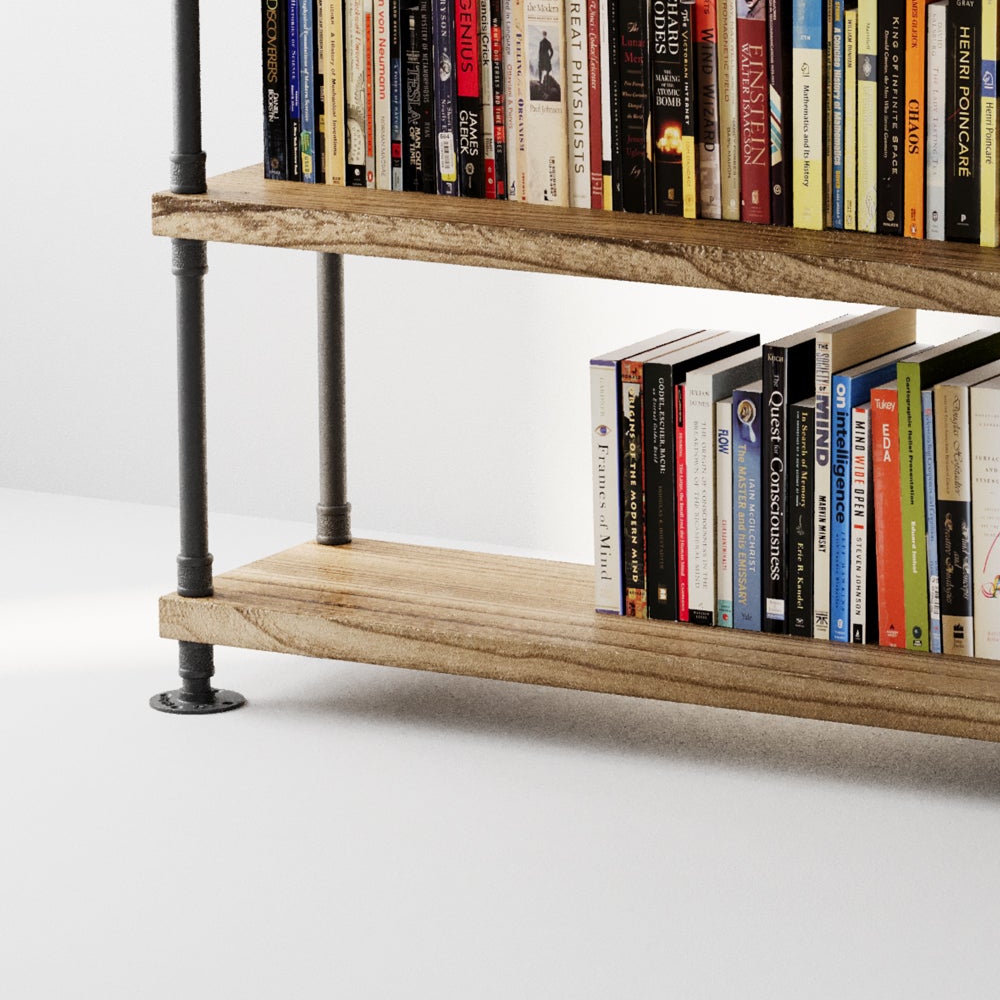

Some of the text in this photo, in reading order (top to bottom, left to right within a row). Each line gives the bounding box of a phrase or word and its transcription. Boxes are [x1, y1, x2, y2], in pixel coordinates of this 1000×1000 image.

[378, 38, 387, 99] Neumann
[482, 35, 490, 66] Crick
[572, 60, 585, 174] PHYSICISTS
[701, 28, 716, 152] WIND WIZARD
[750, 45, 765, 166] EINSTEIN
[958, 26, 972, 176] HENRI POINCARÉ
[460, 110, 469, 154] GLEICK
[469, 111, 478, 156] JAMES
[908, 100, 920, 154] CHAOS
[985, 102, 994, 164] Henri Poincaré
[802, 161, 810, 186] History
[718, 429, 728, 454] FLOW
[770, 390, 783, 442] Quest
[835, 383, 848, 523] on intelligence
[854, 421, 864, 517] MIND WIDE OPEN
[598, 444, 612, 580] Frames of Mind
[770, 457, 784, 581] Consciousness
